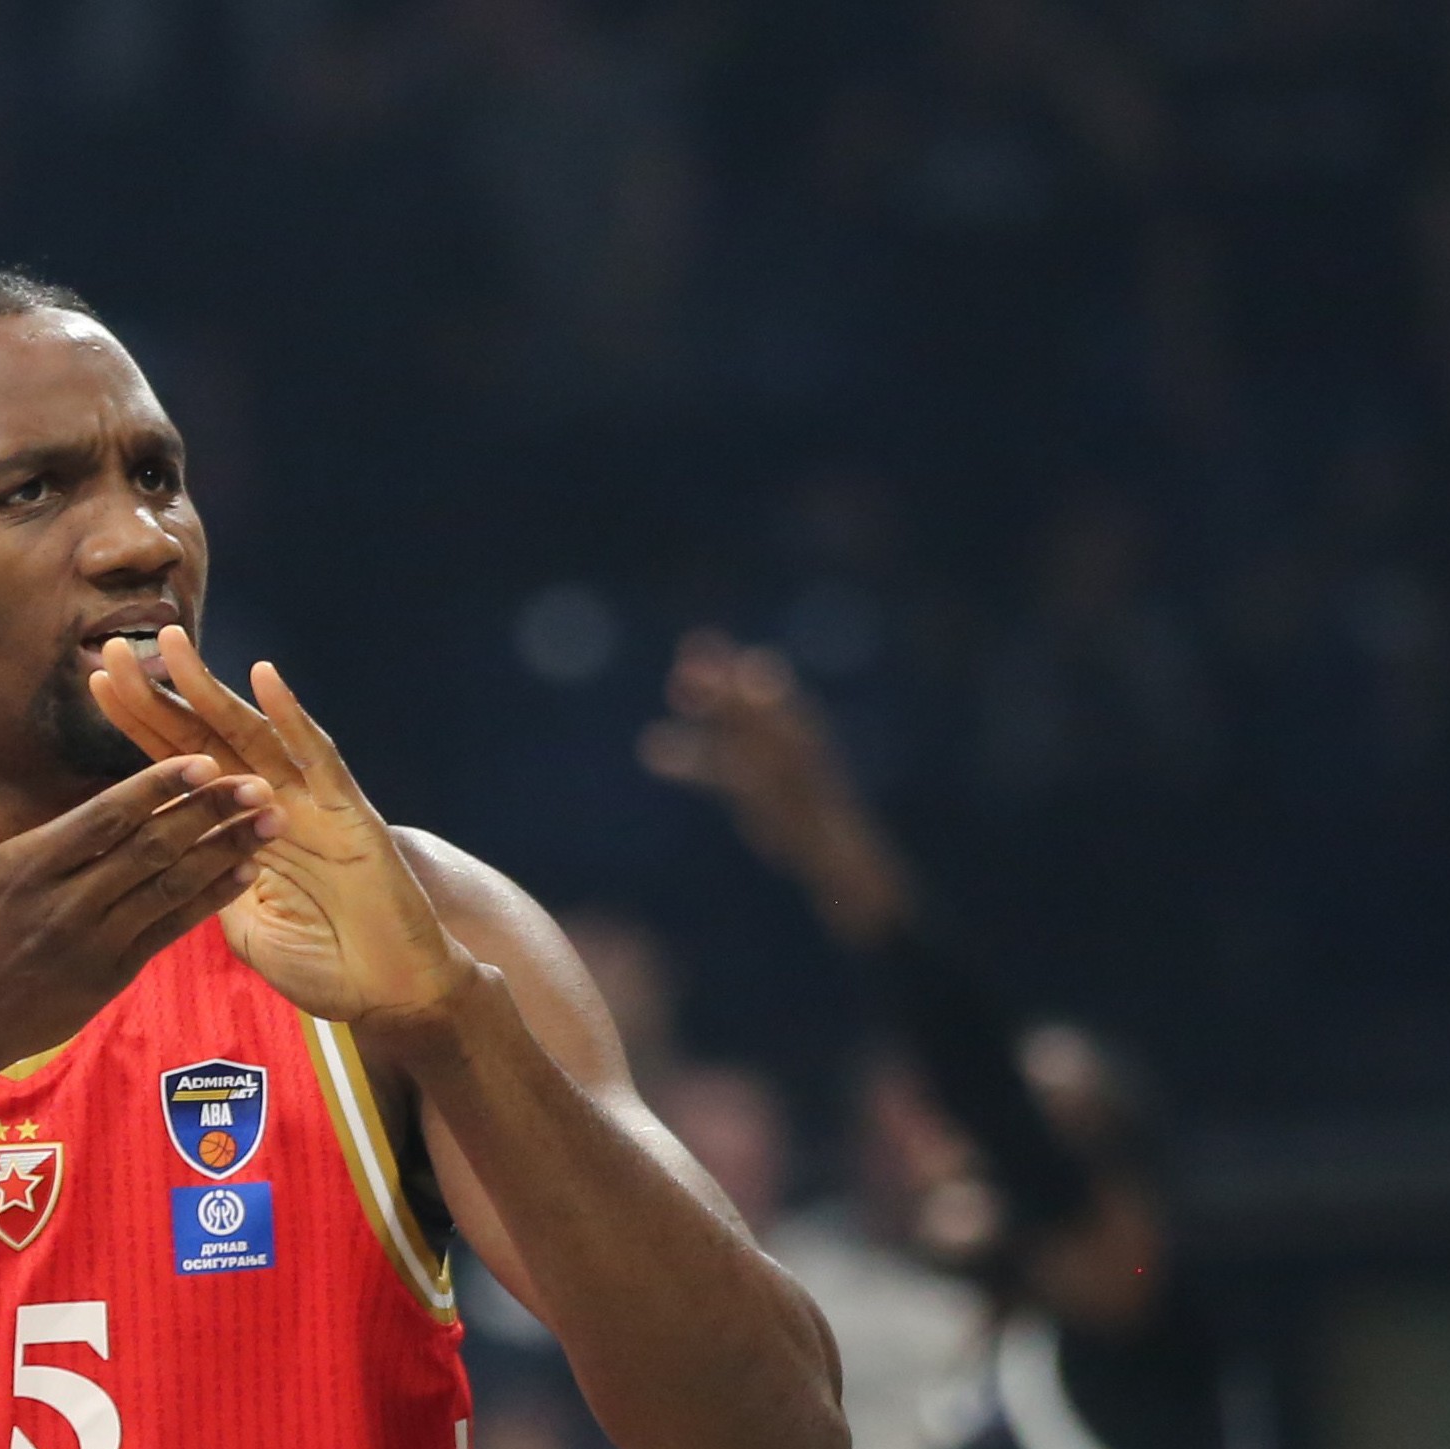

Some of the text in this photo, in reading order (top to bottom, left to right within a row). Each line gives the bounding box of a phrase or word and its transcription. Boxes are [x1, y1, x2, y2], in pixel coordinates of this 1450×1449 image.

[177, 1073, 259, 1090] ADMIRAL
[200, 1102, 233, 1127] ABA
[201, 1241, 247, 1256] ДУНАВ
[182, 1254, 267, 1271] ОСИГУРАЊЕ
